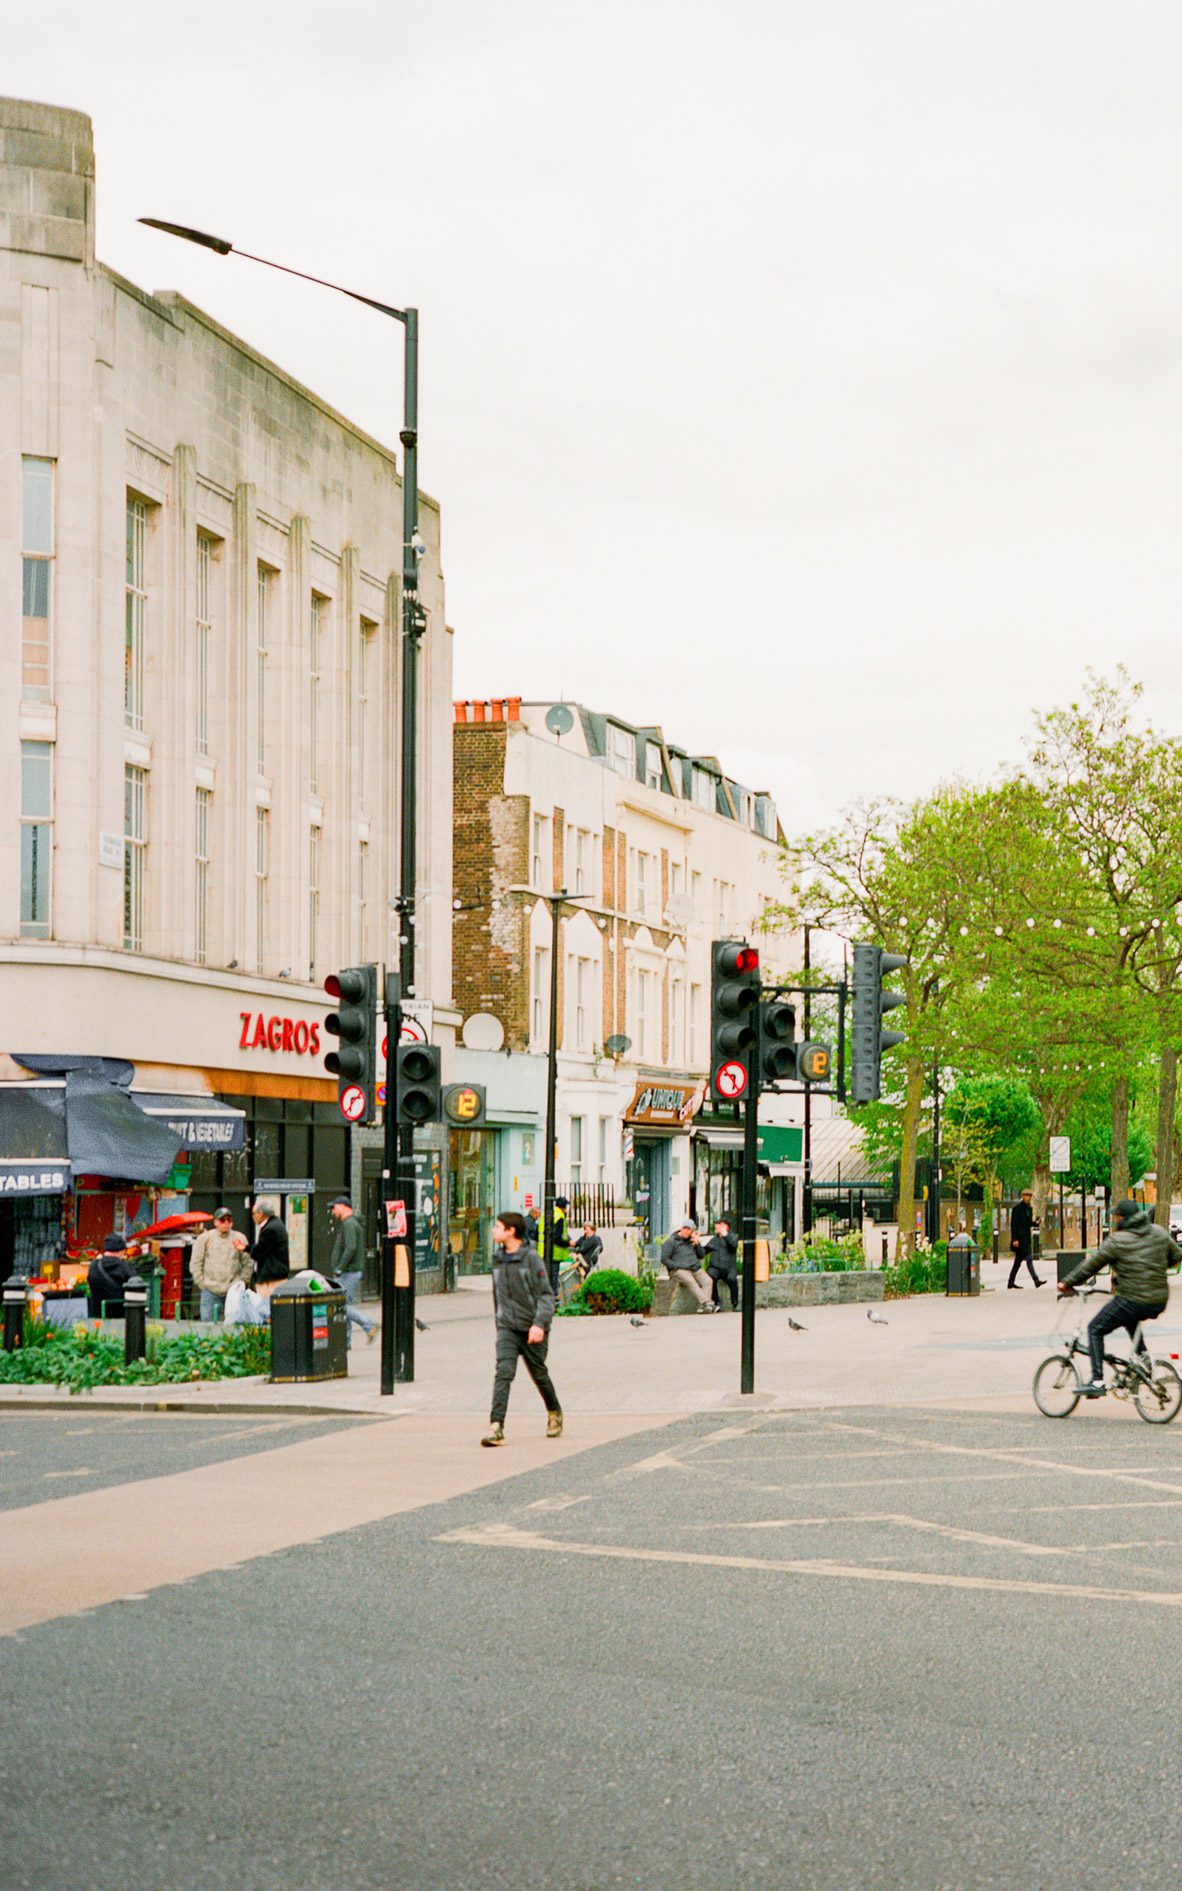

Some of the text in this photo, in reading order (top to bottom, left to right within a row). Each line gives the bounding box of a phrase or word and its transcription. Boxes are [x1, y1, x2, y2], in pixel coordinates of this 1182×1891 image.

[240, 1012, 320, 1055] ZAGROS
[459, 1093, 477, 1117] 12
[651, 1087, 685, 1111] UNIQUE
